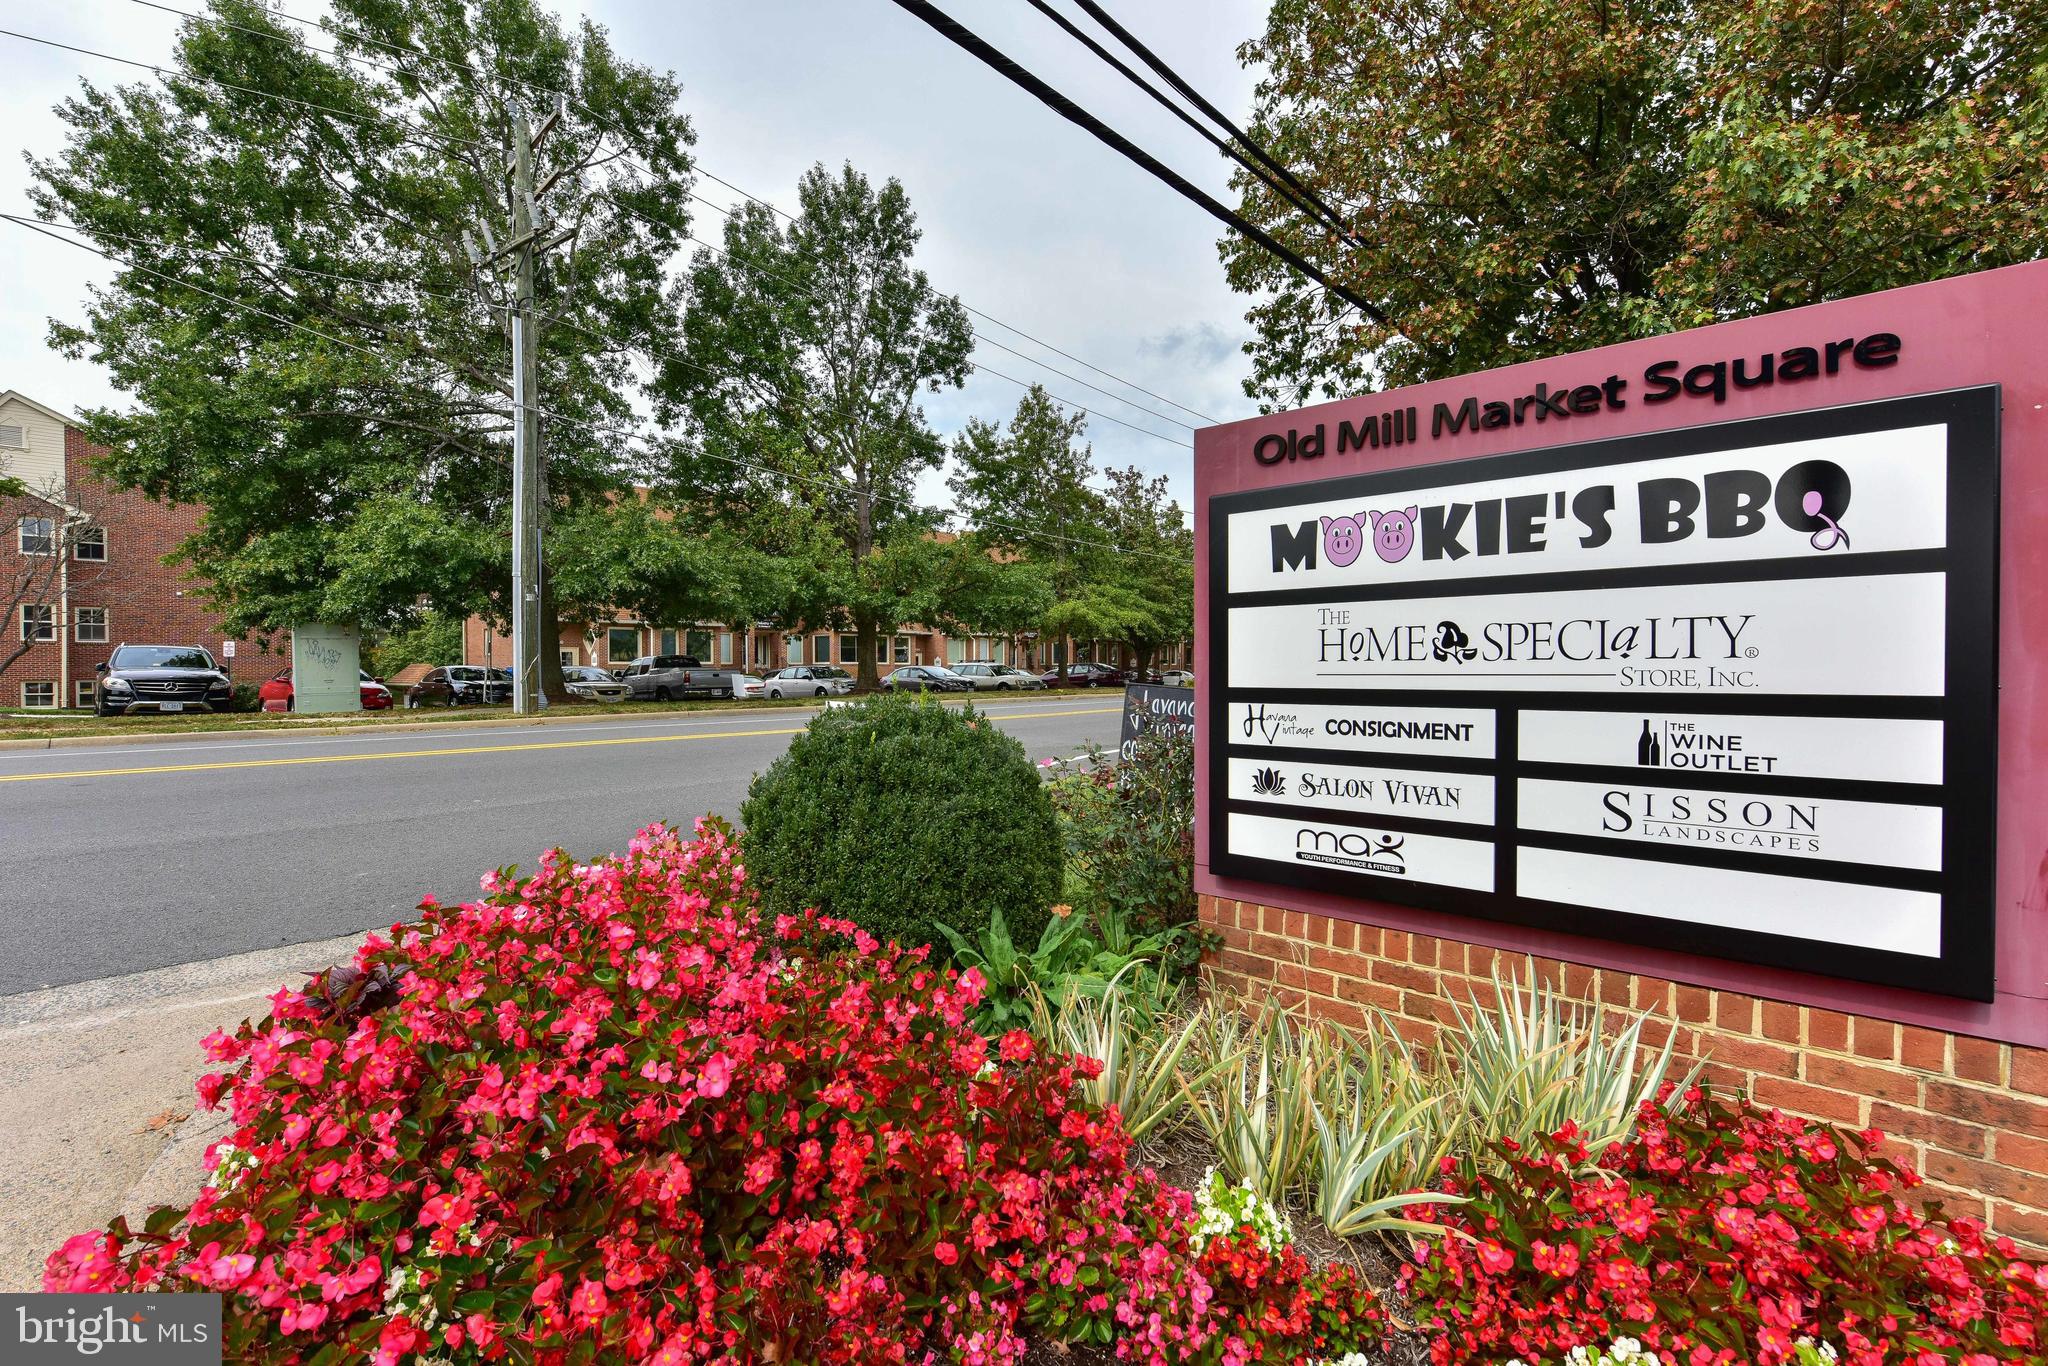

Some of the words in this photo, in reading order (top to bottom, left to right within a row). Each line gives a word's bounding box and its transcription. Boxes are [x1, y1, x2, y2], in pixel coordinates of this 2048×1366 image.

[1253, 424, 1324, 464] Old
[1337, 407, 1417, 452] Mill
[1431, 375, 1627, 438] Market
[1643, 331, 1902, 402] Square
[1637, 459, 1852, 551] BBQ
[1243, 703, 1298, 738] Havana
[1263, 719, 1316, 745] Vintage
[1325, 719, 1475, 742] CONSIGNMENT
[1669, 723, 1696, 732] THE
[1670, 733, 1743, 752] WINE
[1670, 752, 1778, 774] OUTLET
[1298, 772, 1376, 802] SALON
[1382, 779, 1462, 810] VIVAN
[1602, 790, 1821, 834] SISSON
[1296, 828, 1406, 864] max
[1642, 823, 1821, 853] LANDSCAPES
[1300, 852, 1322, 862] YOUTH
[1321, 855, 1368, 869] PERFORMANCE
[1373, 862, 1401, 873] FITNESS
